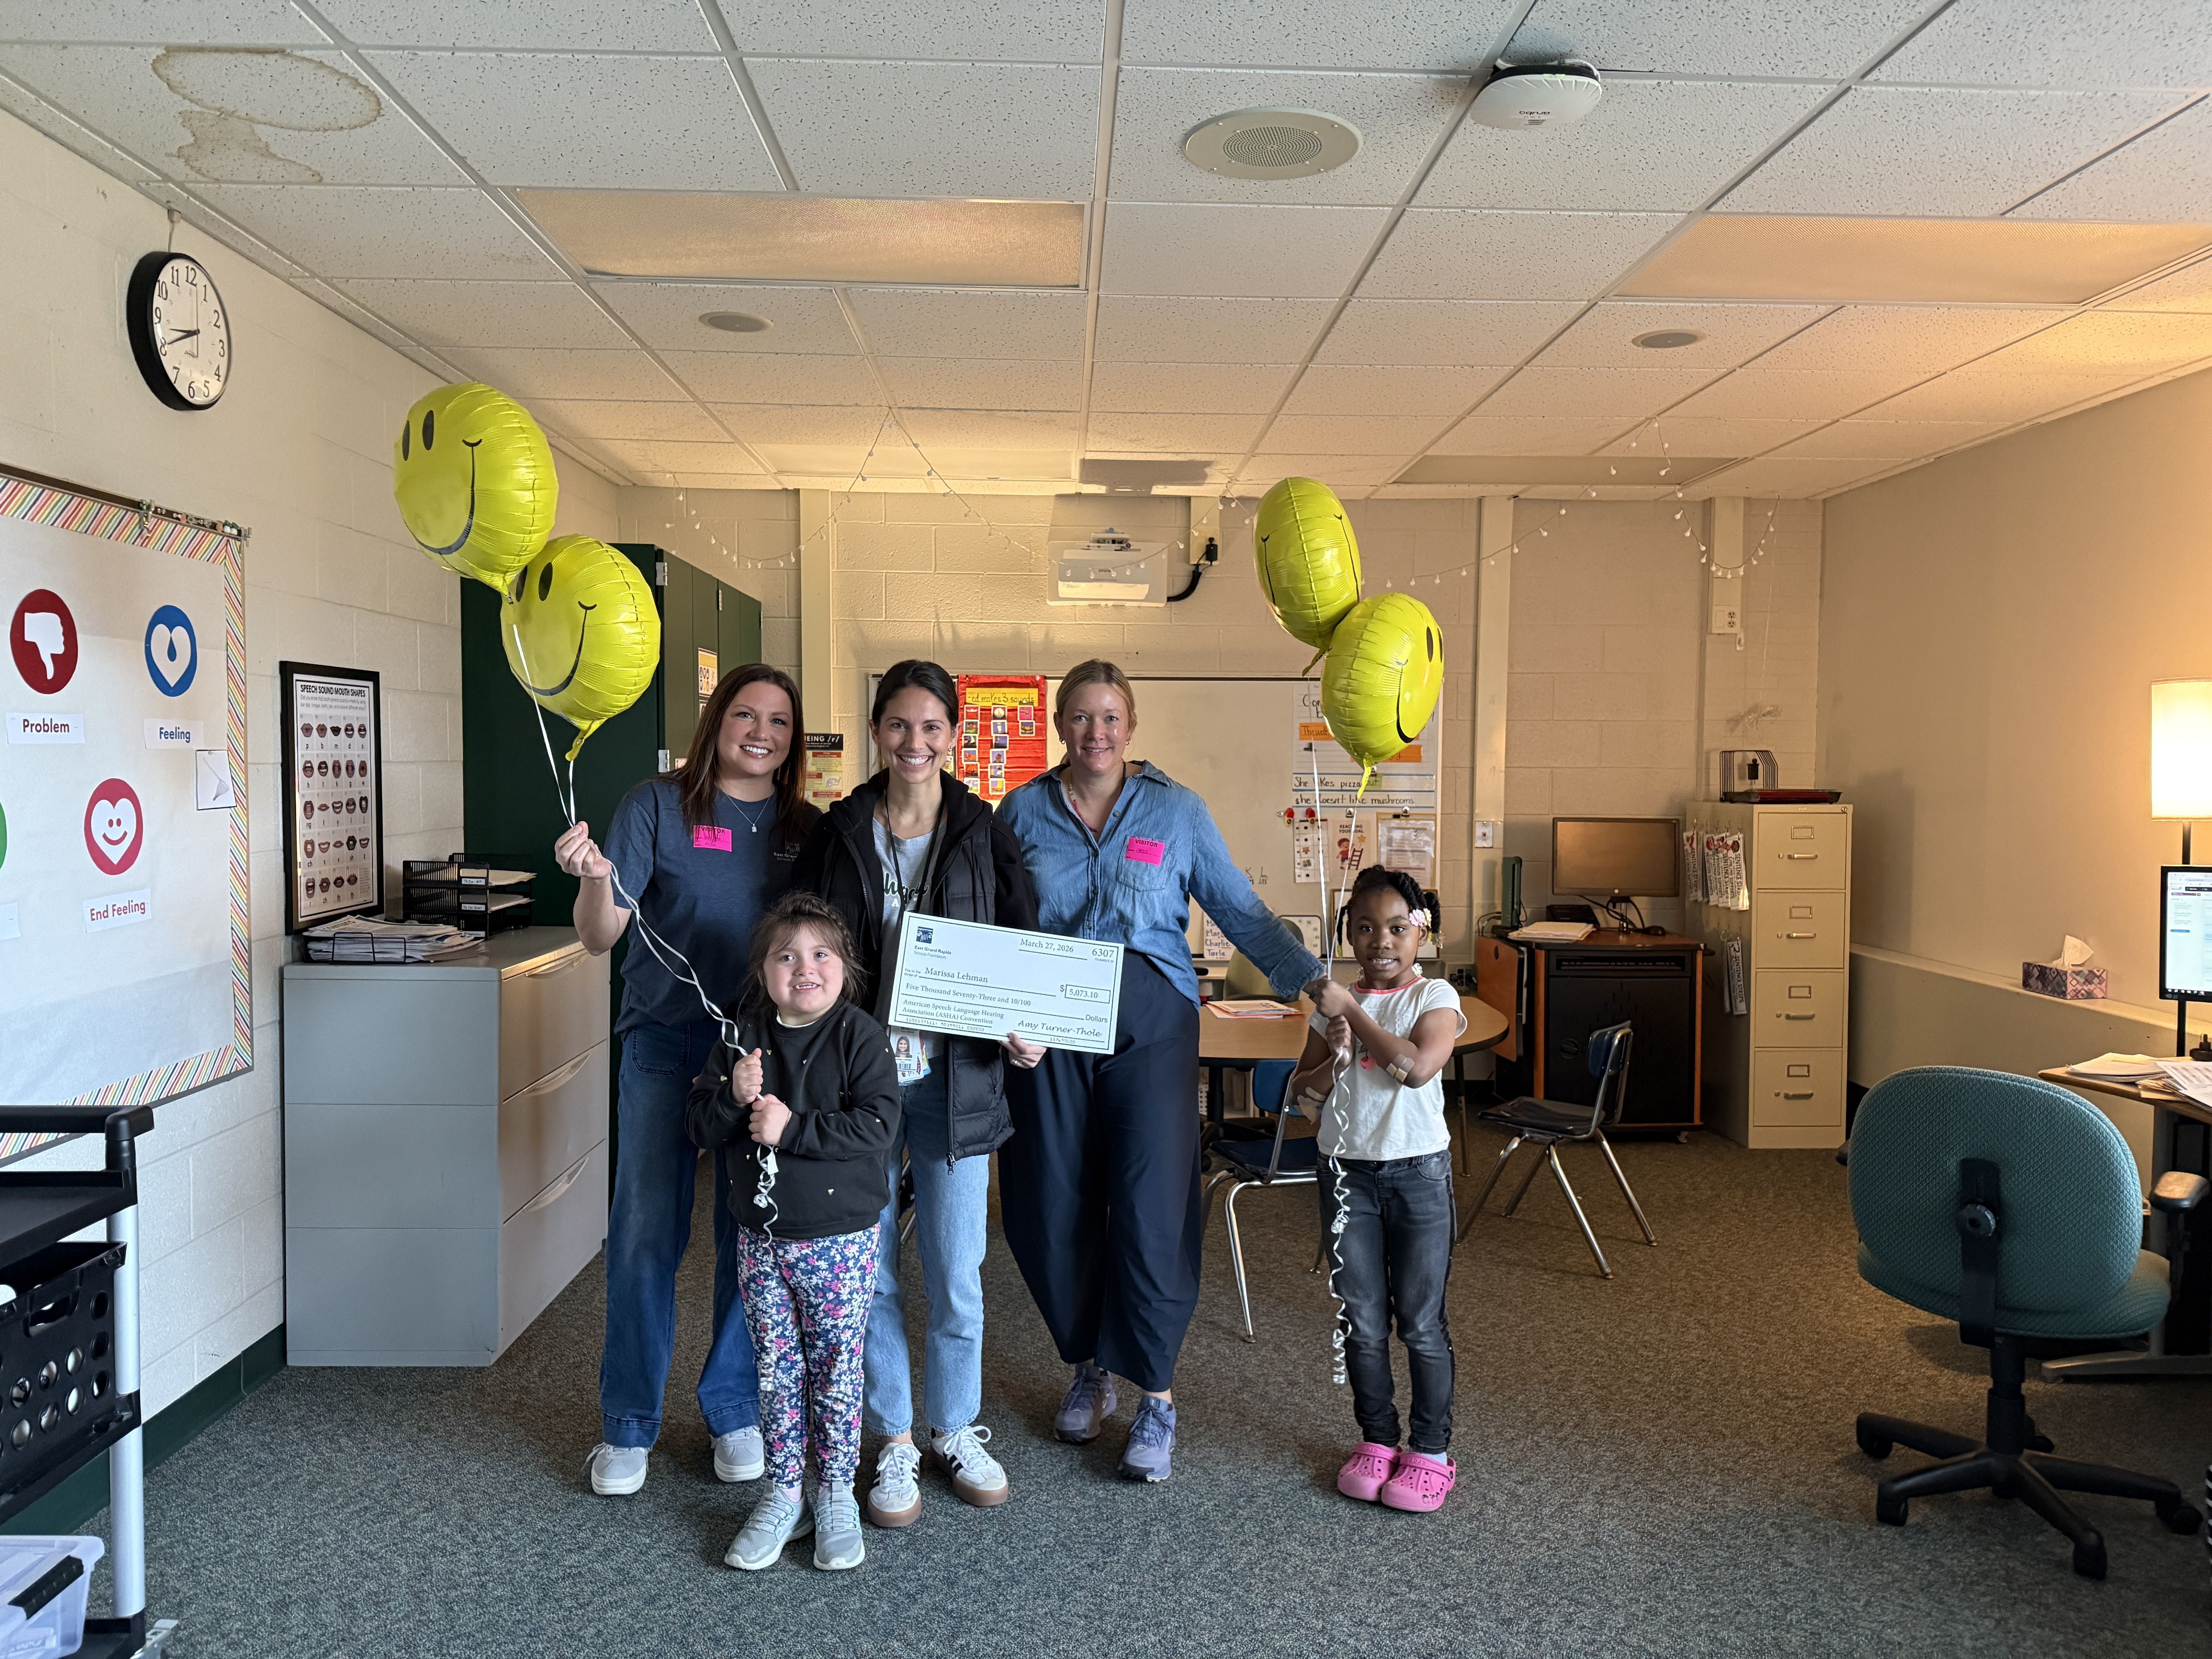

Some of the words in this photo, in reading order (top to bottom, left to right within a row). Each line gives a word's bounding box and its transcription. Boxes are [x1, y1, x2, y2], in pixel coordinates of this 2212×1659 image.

[171, 266, 180, 287] 11
[185, 265, 197, 287] 12
[158, 279, 168, 300] 10
[203, 284, 207, 302] 1
[155, 307, 161, 324] 9
[213, 310, 220, 329] 2
[160, 337, 167, 356] 8
[219, 340, 225, 357] 3
[173, 366, 180, 384] 7
[214, 364, 221, 382] 4
[188, 381, 195, 398] 6
[203, 380, 210, 398] 5
[301, 685, 318, 693] SPEECH
[318, 686, 333, 694] SOUND
[335, 687, 349, 696] MOUTH
[350, 689, 366, 697] SHAPES
[981, 693, 1001, 703] makes
[1002, 693, 1008, 702] 3
[23, 718, 69, 733] Problem
[159, 726, 191, 743] Feeling
[1294, 777, 1308, 787] She
[1313, 777, 1334, 787] lkes
[1295, 794, 1311, 804] she
[1371, 794, 1414, 804] mushrooms
[1135, 839, 1158, 847] VISITOR
[90, 904, 109, 921] End
[112, 900, 146, 917] Feeling
[1020, 939, 1043, 948] March
[1057, 944, 1073, 952] 2026
[1205, 939, 1231, 947] Charlie
[1092, 948, 1114, 958] 6307
[925, 967, 955, 978] Marissa
[957, 972, 988, 982] Lehman
[921, 985, 951, 995] Thousand
[952, 990, 996, 1001] Seventy-Three
[1011, 998, 1031, 1006] 10/100
[1060, 984, 1065, 993] $
[1069, 989, 1098, 999] 5,073.10
[902, 1007, 934, 1017] Association
[936, 1011, 959, 1020] (ASHA)
[960, 1015, 993, 1024] Convention
[903, 999, 930, 1008] American
[932, 1003, 980, 1015] Speech-Language
[982, 1010, 1004, 1019] Hearing
[1085, 1014, 1108, 1023] Dollars
[1018, 1020, 1038, 1030] Amy
[1041, 1023, 1102, 1037] Turner-Thole
